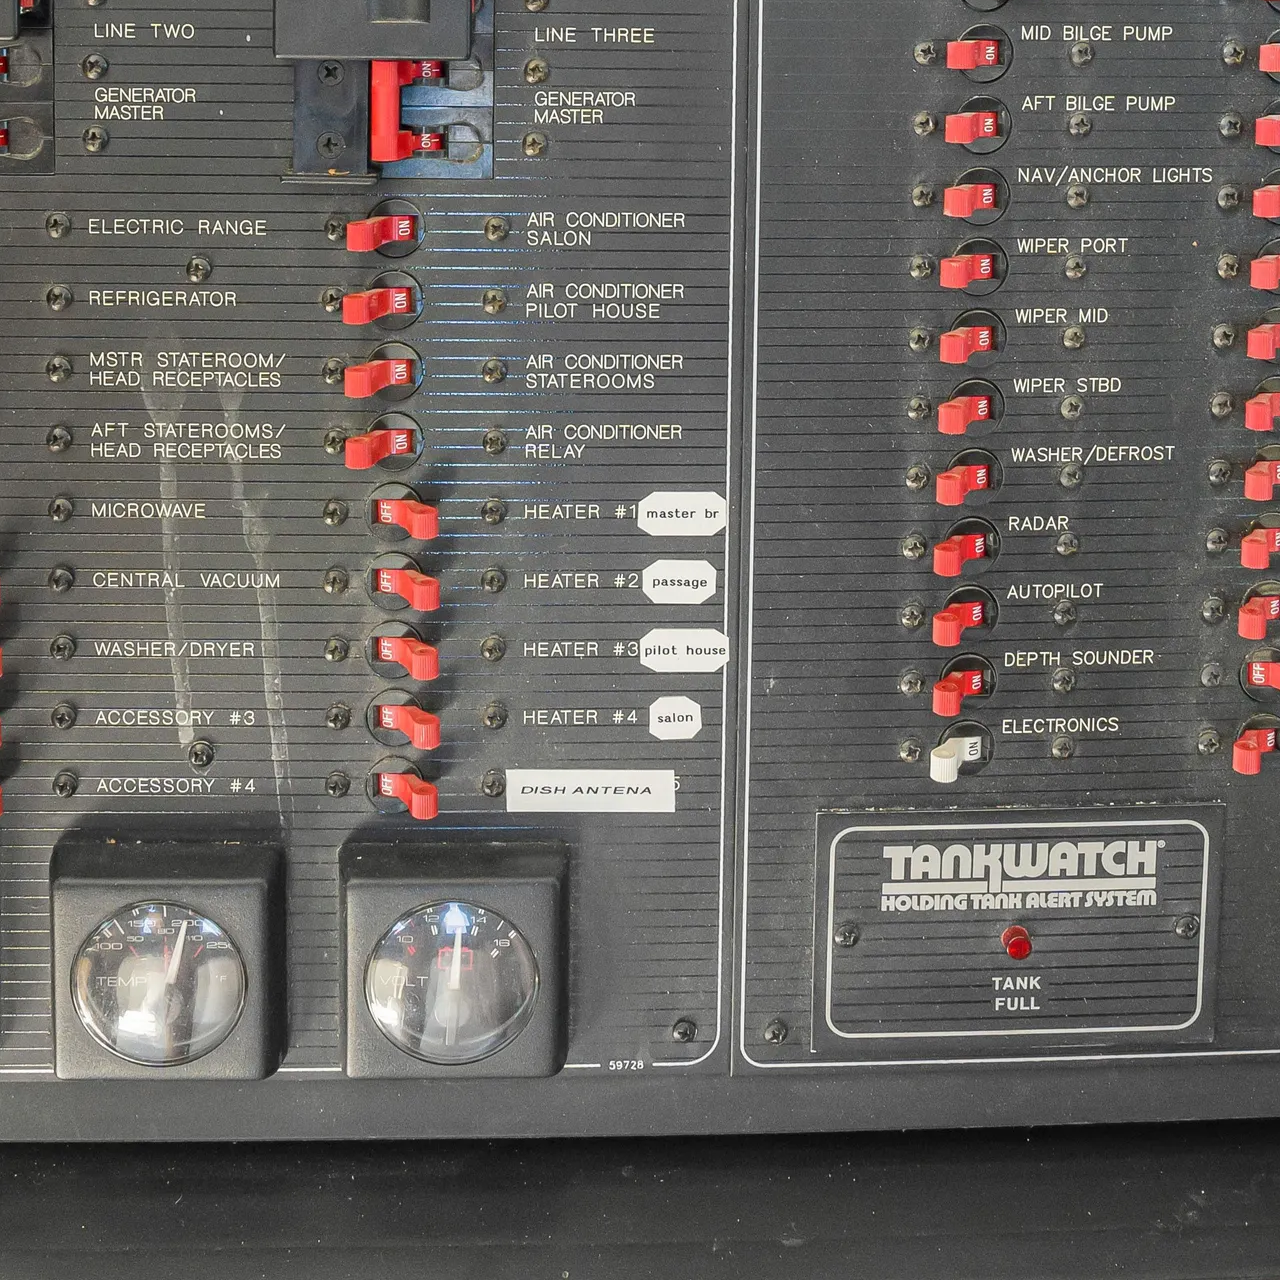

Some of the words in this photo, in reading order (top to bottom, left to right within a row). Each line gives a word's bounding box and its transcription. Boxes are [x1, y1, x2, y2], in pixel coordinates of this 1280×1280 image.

[534, 27, 577, 43] LINE
[590, 27, 655, 44] THREE
[1018, 165, 1142, 187] NAV/ANCHOR
[1152, 167, 1213, 183] LIGHTS
[88, 218, 184, 235] ELECTRIC
[198, 219, 267, 236] RANGE
[525, 354, 554, 369] AIR
[564, 353, 683, 370] CONDITIONER
[525, 373, 655, 389] STATEROOMS
[652, 578, 708, 590] passage
[1006, 583, 1104, 600] AUTOPILOT
[93, 639, 255, 659] WASHER/DRYER
[1004, 650, 1061, 667] DEPTH
[1072, 649, 1154, 666] SOUNDER
[523, 709, 598, 725] HEATER
[612, 709, 638, 724] #4
[657, 712, 694, 724] salon
[520, 786, 566, 795] DISH
[571, 786, 652, 795] ANTENA
[881, 893, 968, 912] HOLDING
[970, 892, 1023, 910] TANK
[1025, 890, 1083, 909] ALERT
[1084, 888, 1157, 908] SYSTEM
[96, 975, 147, 989] TEMP
[995, 996, 1041, 1011] FULL
[608, 1059, 644, 1071] 59728
